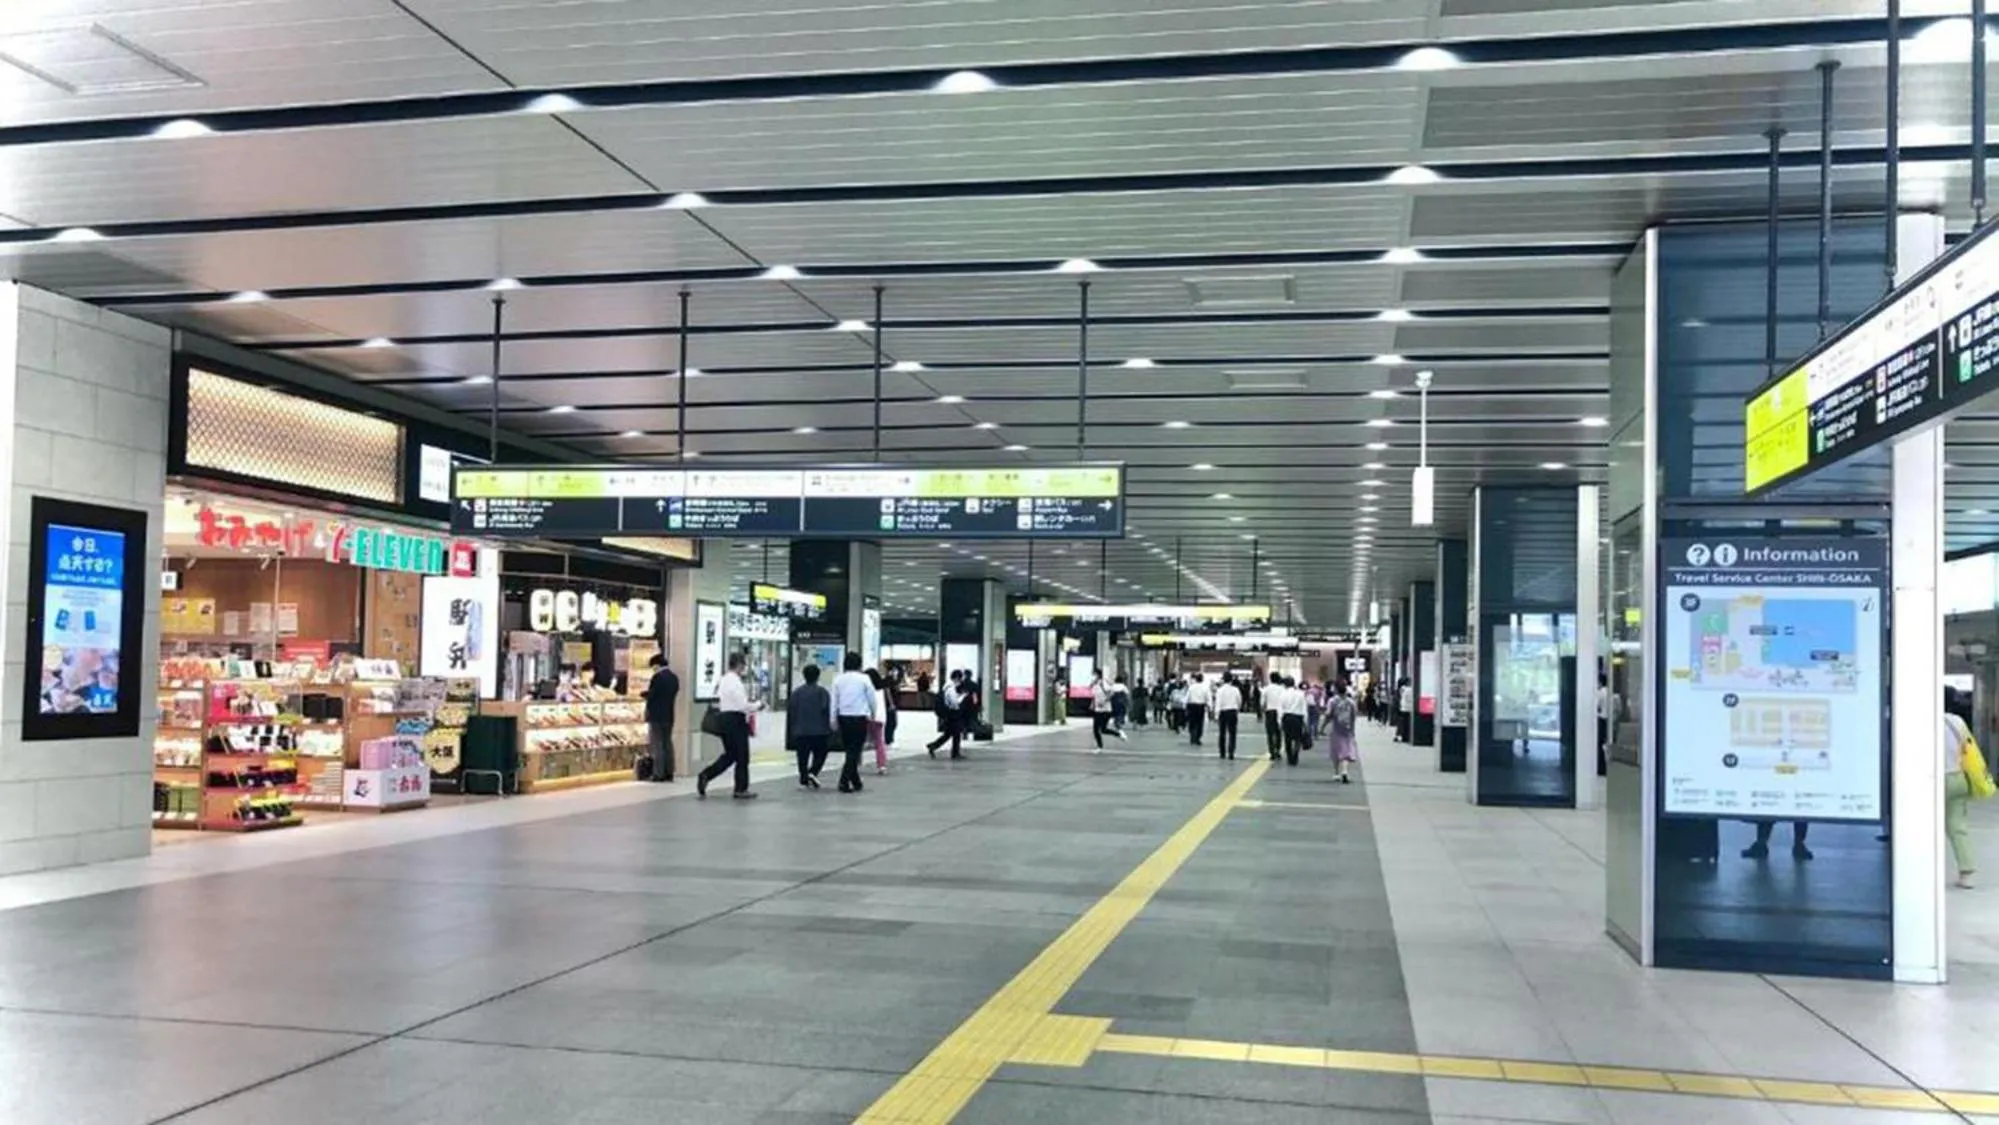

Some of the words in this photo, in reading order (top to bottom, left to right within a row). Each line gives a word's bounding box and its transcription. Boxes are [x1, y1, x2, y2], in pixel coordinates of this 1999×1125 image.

[194, 505, 315, 557] おみやげ
[1743, 546, 1860, 563] Information
[1675, 573, 1710, 584] Travel
[1712, 573, 1752, 584] Service
[1755, 573, 1794, 584] Center
[1796, 573, 1872, 584] SHIN-OSAKA
